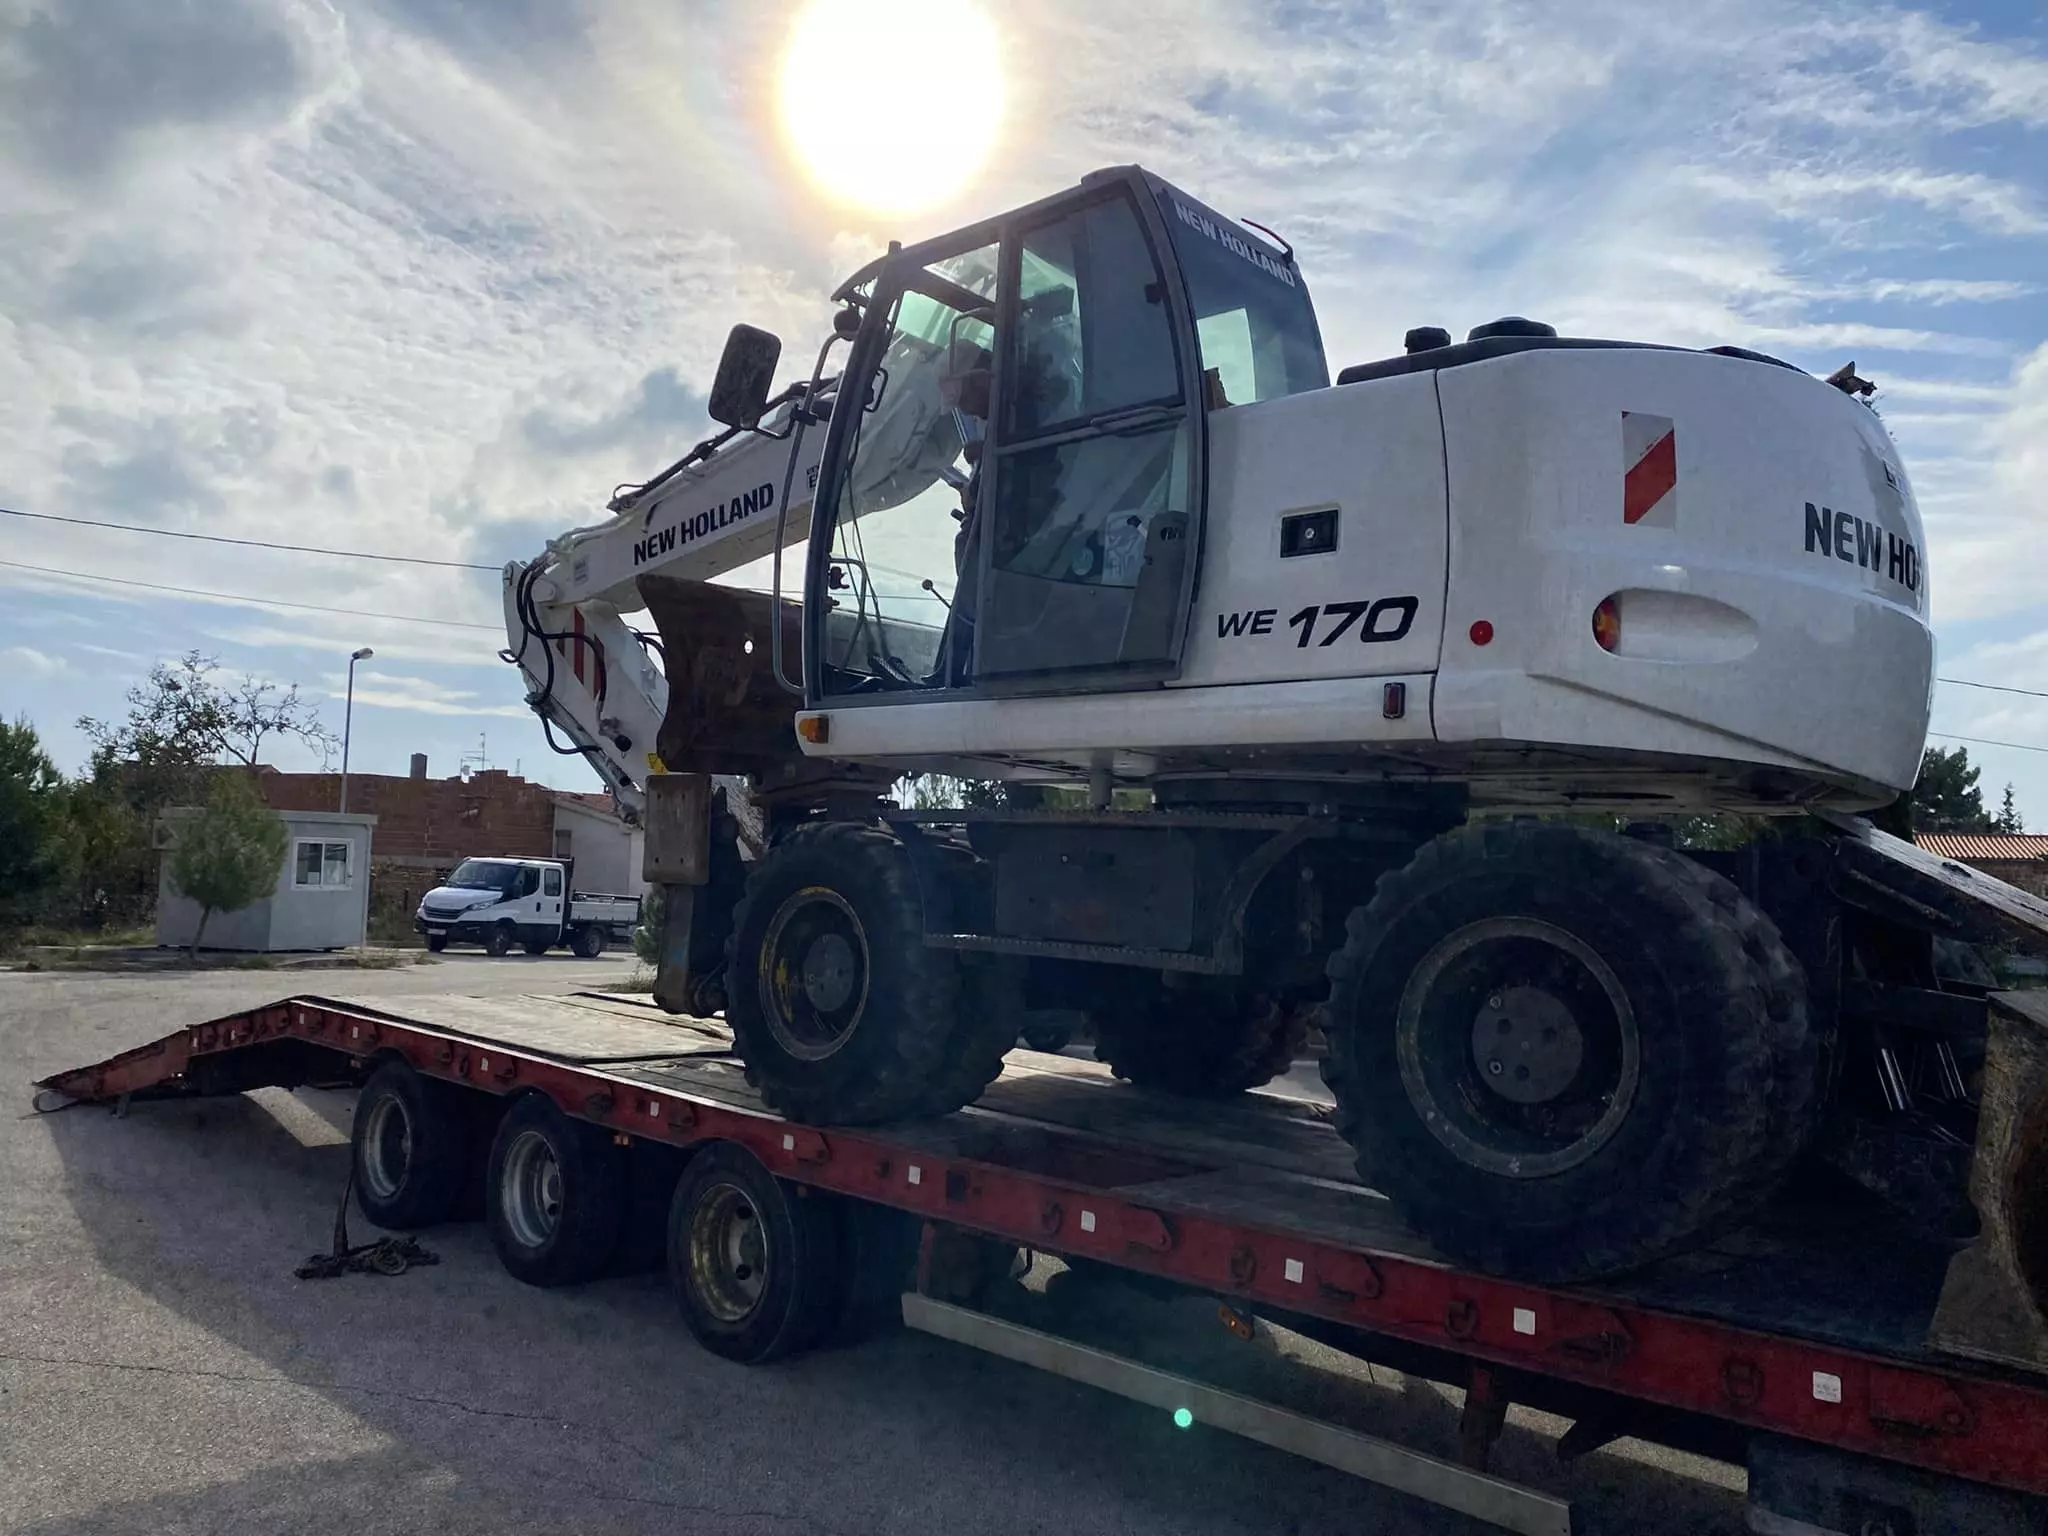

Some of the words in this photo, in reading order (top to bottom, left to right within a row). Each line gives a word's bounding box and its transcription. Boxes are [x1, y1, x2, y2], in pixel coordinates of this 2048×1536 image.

[1174, 200, 1217, 241] NEW
[1219, 228, 1296, 288] HOLLAND
[633, 525, 676, 565] NEW
[681, 482, 774, 544] HOLLAND
[1805, 501, 1882, 573] NEW
[1888, 532, 1920, 593] HO
[1217, 608, 1278, 639] WE
[1288, 595, 1420, 649] 170
